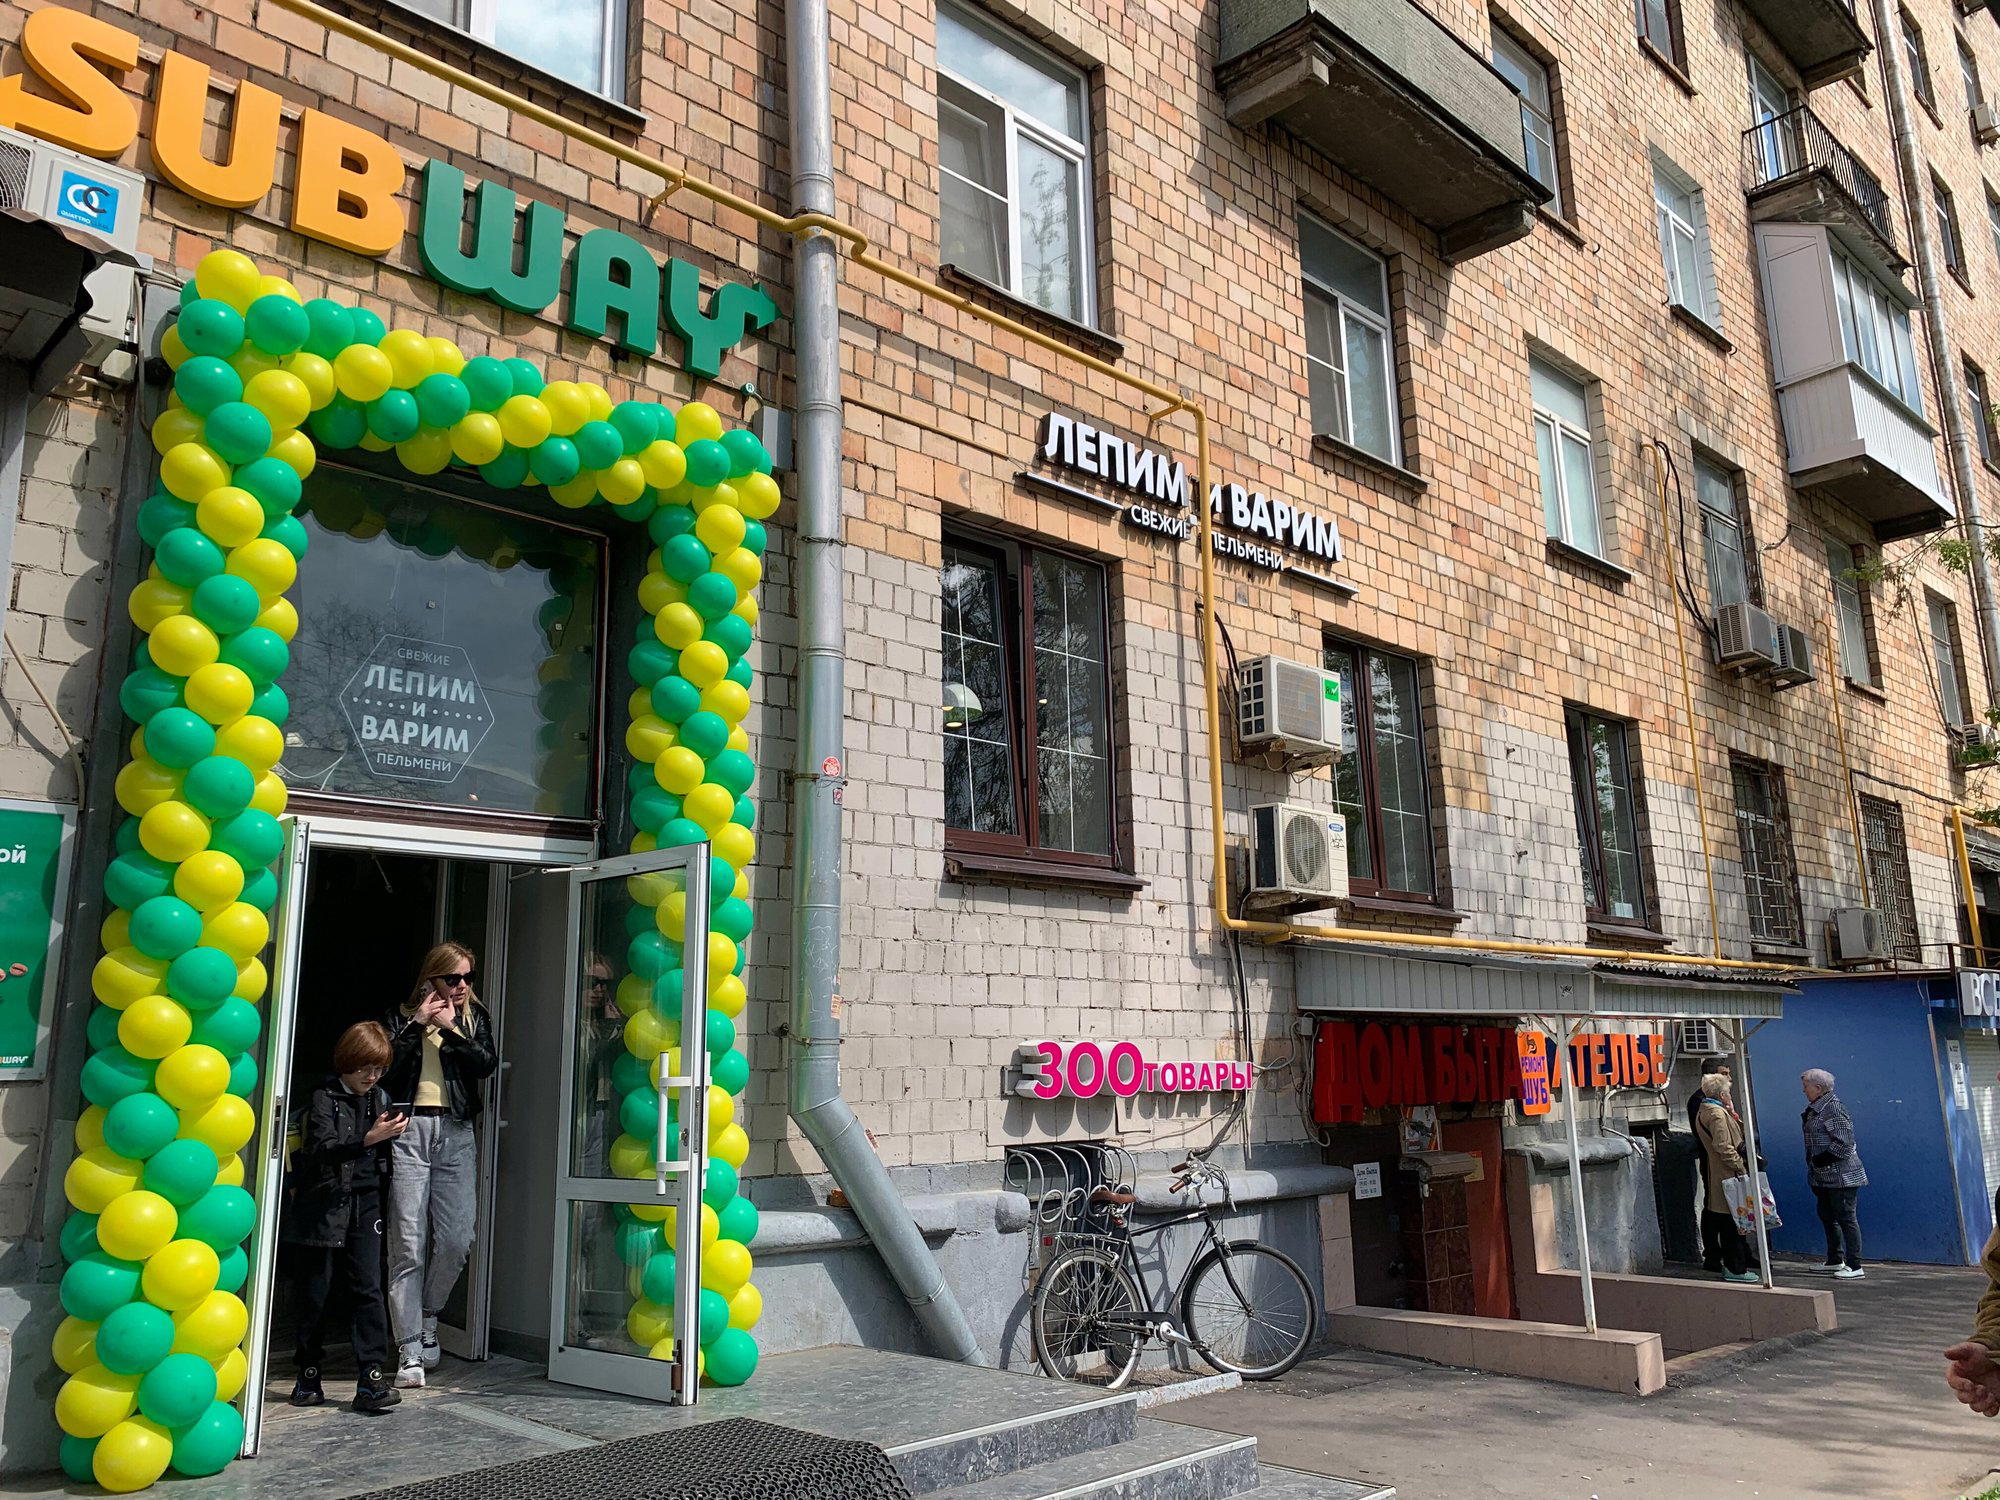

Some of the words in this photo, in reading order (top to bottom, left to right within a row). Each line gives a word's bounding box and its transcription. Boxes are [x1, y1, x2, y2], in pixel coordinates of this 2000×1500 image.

[0, 7, 782, 379] SUBWAY
[1045, 411, 1187, 508] ЛЕПИМ
[1230, 482, 1342, 562] ВАРИМ
[397, 647, 451, 666] СВЕЖИЕ
[364, 664, 476, 704] ЛЕПИМ
[412, 701, 426, 717] И
[361, 714, 469, 753] ВАРИМ
[376, 752, 452, 772] ПЕЛЬМЕНИ
[1318, 1022, 1427, 1124] ДОМ
[1435, 1025, 1525, 1104] БЫТА
[1520, 1055, 1546, 1074] РЕМОНТ
[1522, 1077, 1548, 1106] ШУБ
